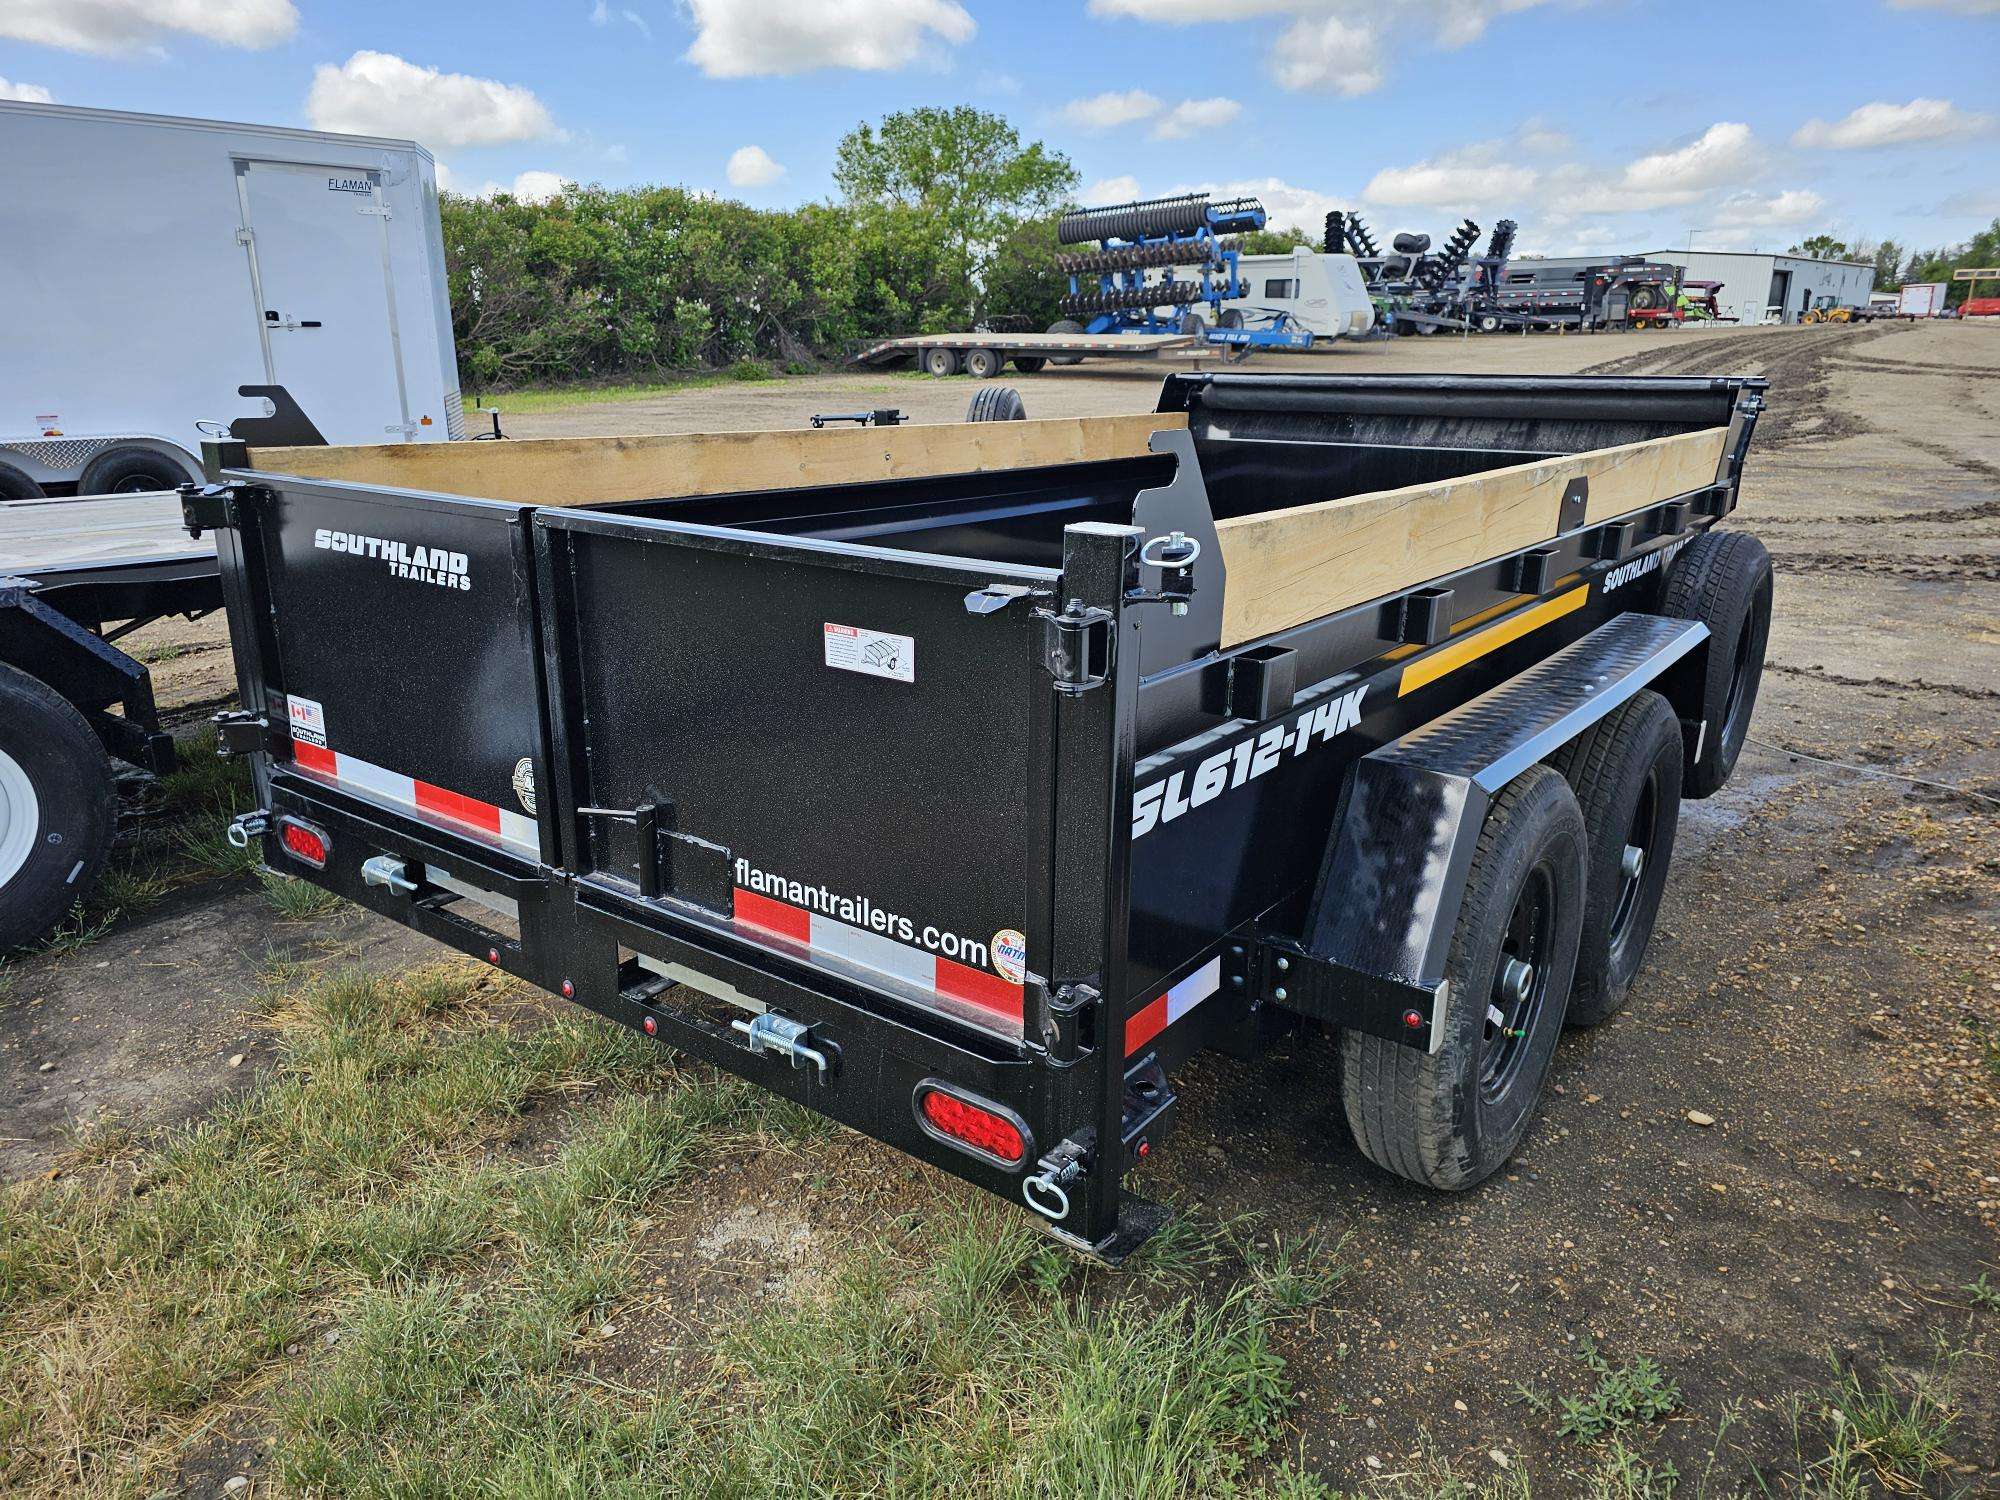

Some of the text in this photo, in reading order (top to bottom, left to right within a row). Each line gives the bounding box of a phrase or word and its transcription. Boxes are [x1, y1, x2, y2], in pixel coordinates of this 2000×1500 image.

[328, 178, 372, 191] FLAMAN
[314, 528, 469, 575] SOUTHLAND
[1602, 550, 1661, 593] SOUTHLAND
[389, 561, 471, 591] TRAILERS
[1132, 684, 1370, 840] SL612-14K
[734, 857, 988, 967] flamantrailers.com
